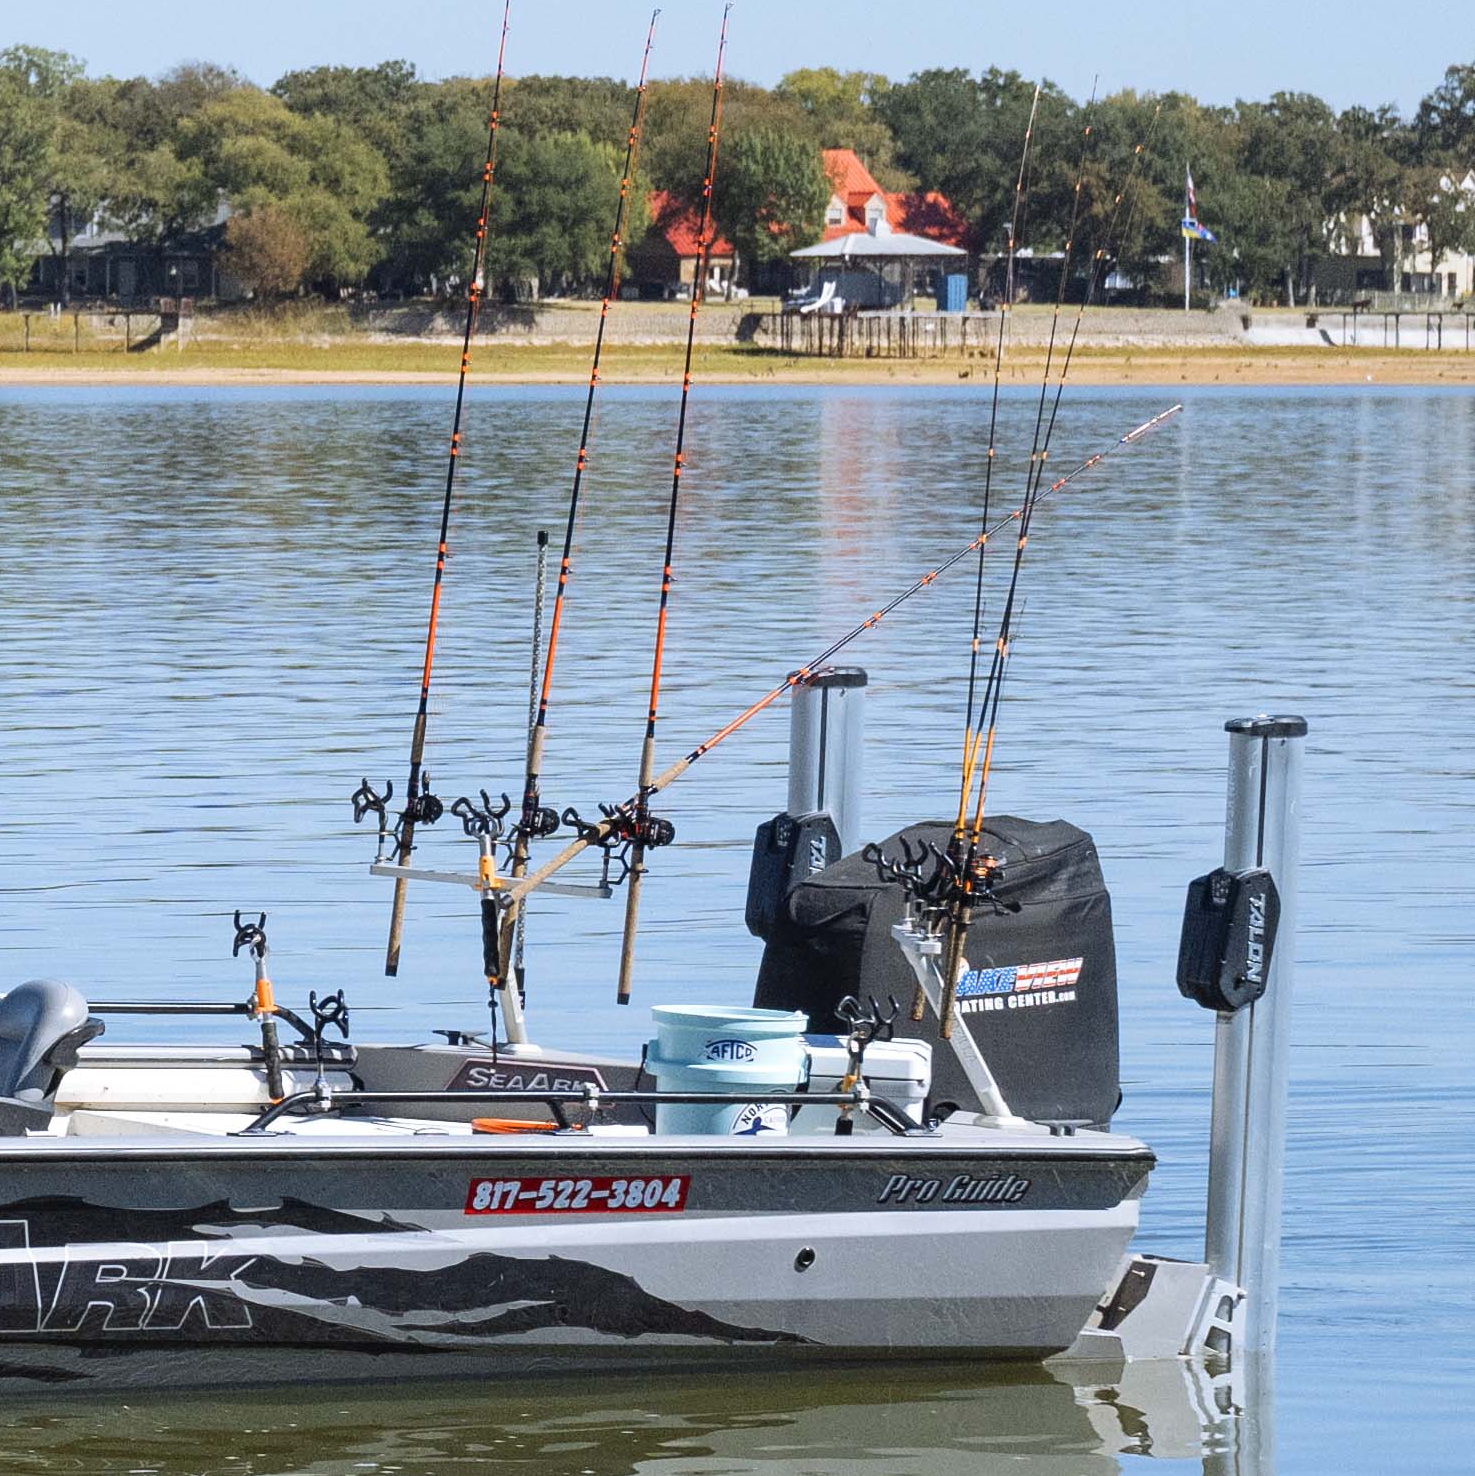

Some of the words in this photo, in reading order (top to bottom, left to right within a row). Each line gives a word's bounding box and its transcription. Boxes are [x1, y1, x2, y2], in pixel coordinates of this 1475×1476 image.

[1246, 893, 1266, 983] TALON
[710, 1040, 753, 1060] AFTCO
[471, 1177, 682, 1211] 817-522-3804
[876, 1174, 942, 1204] Pro
[941, 1173, 1032, 1204] Guide
